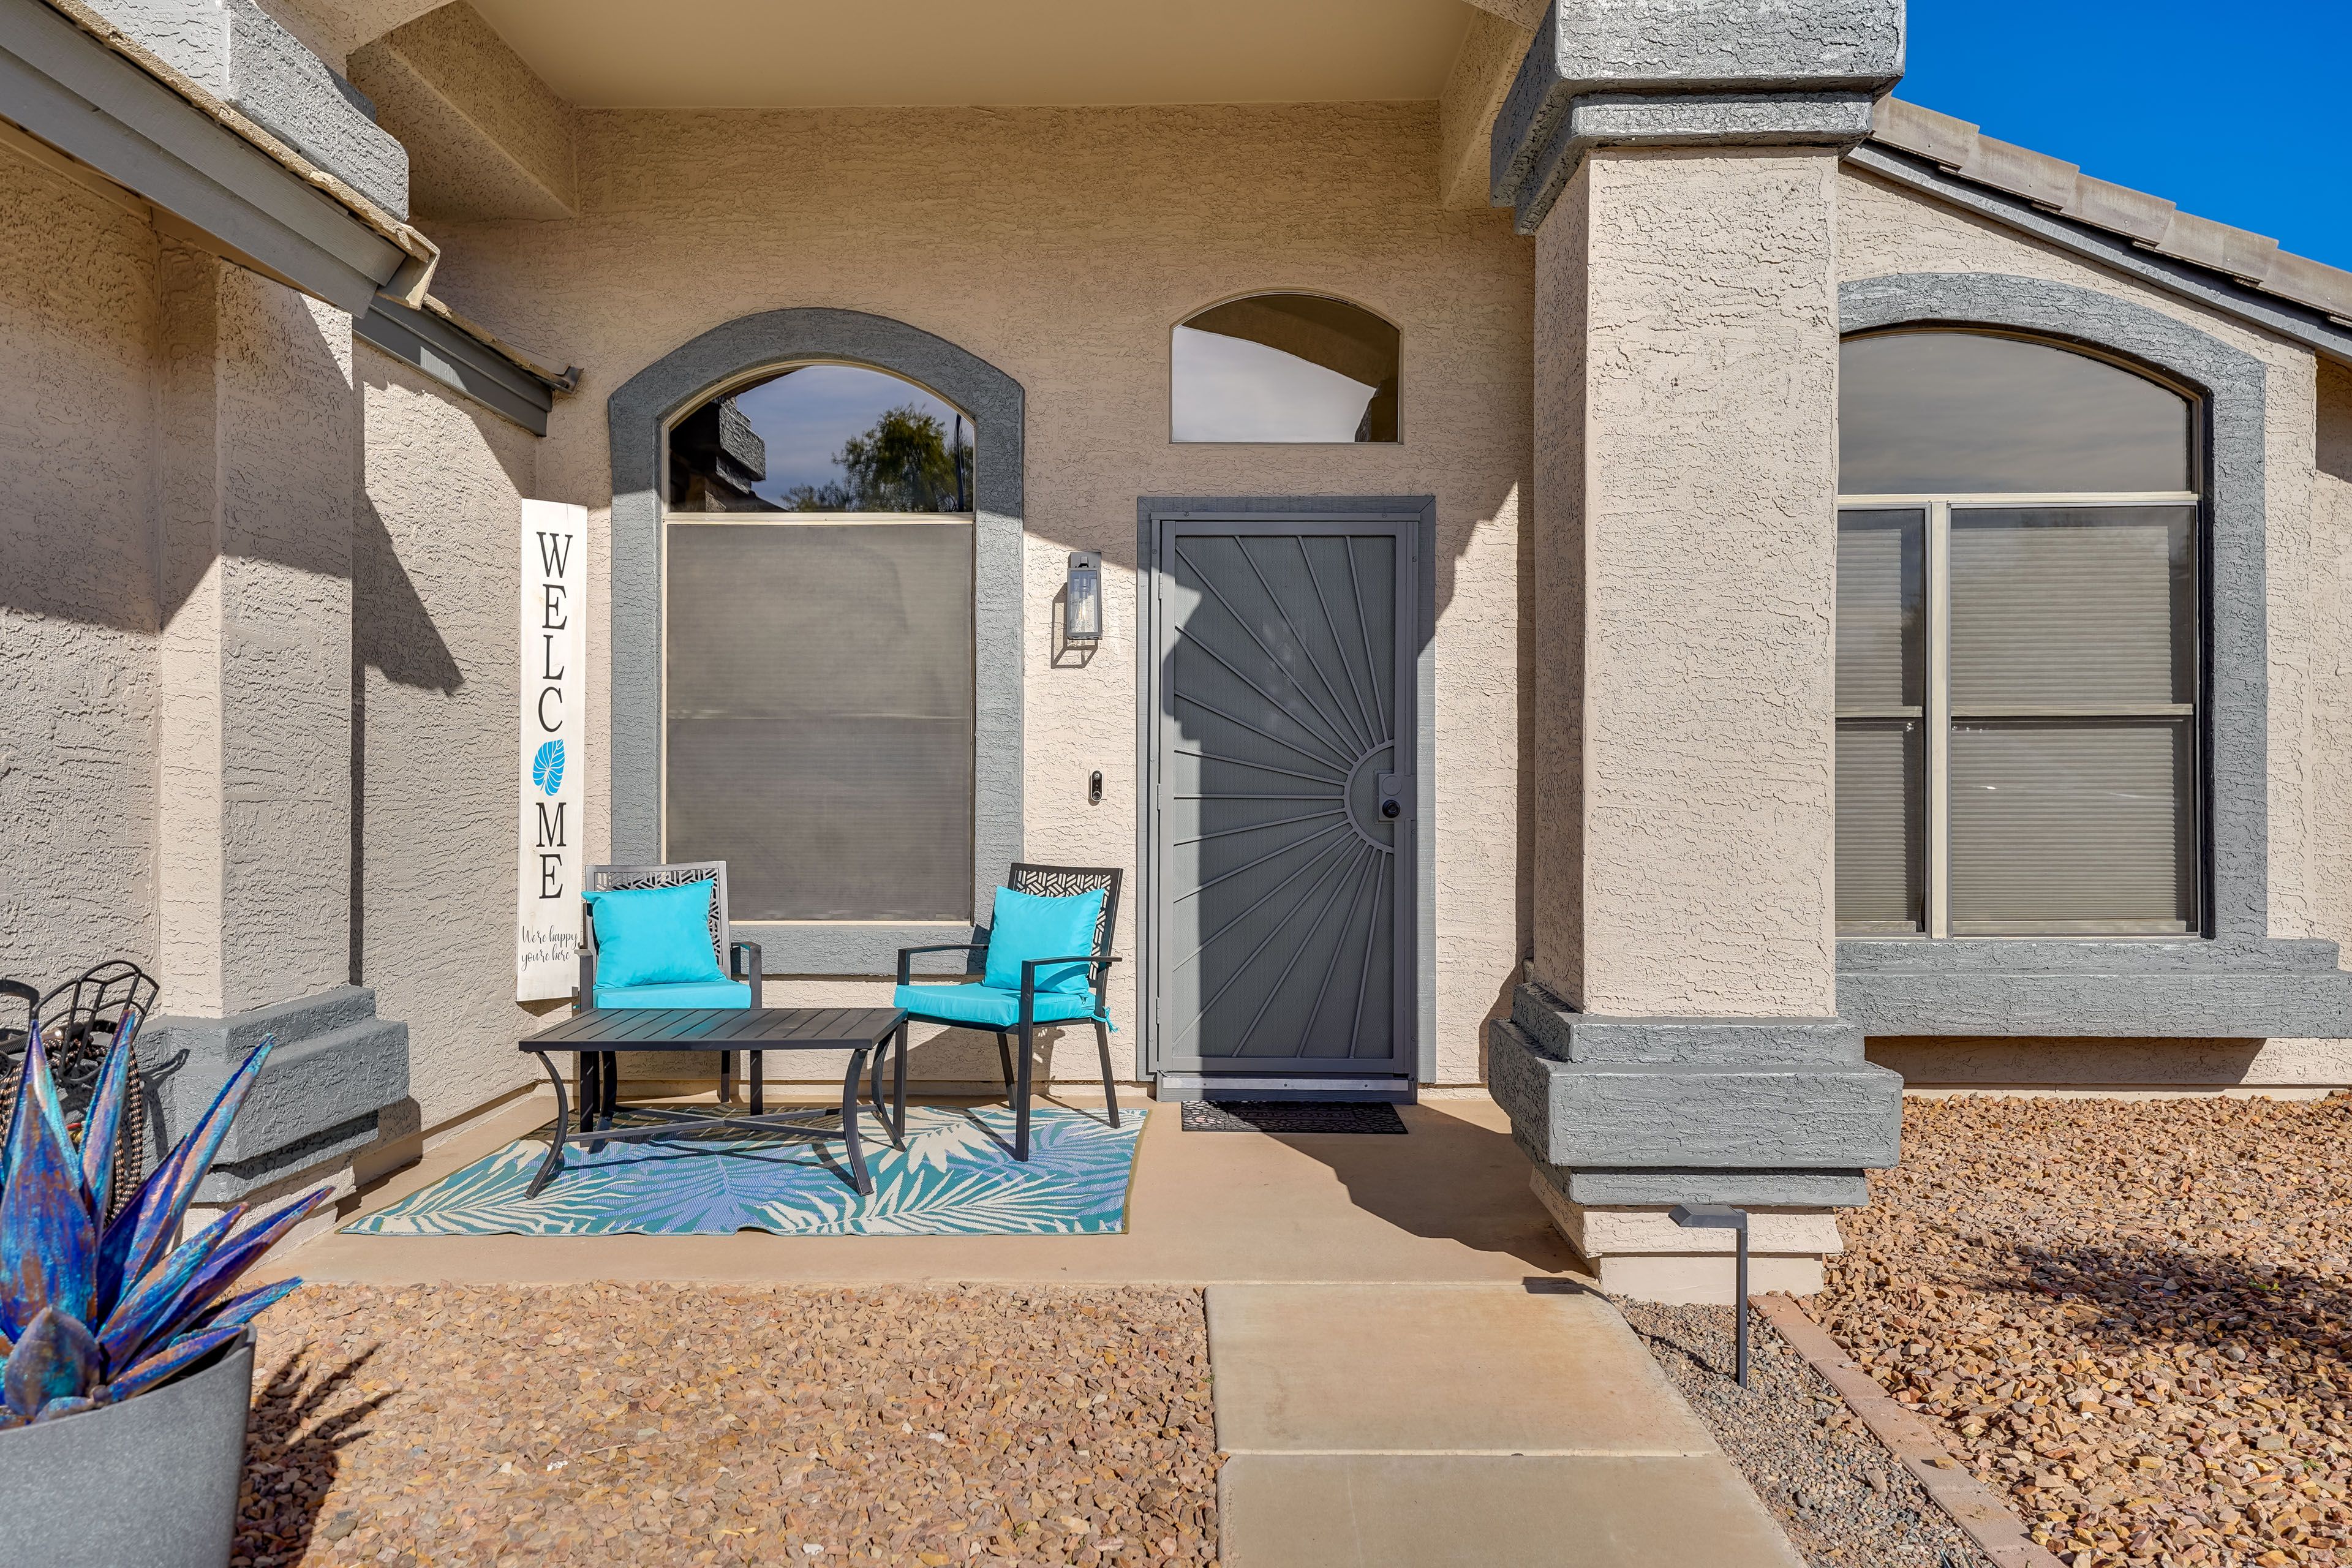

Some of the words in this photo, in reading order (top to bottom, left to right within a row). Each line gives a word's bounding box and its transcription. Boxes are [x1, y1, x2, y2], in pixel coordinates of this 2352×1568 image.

[534, 532, 573, 899] WELCME
[522, 925, 547, 944] We're
[549, 925, 578, 950] happy
[521, 949, 550, 971] you're
[552, 944, 570, 962] here
